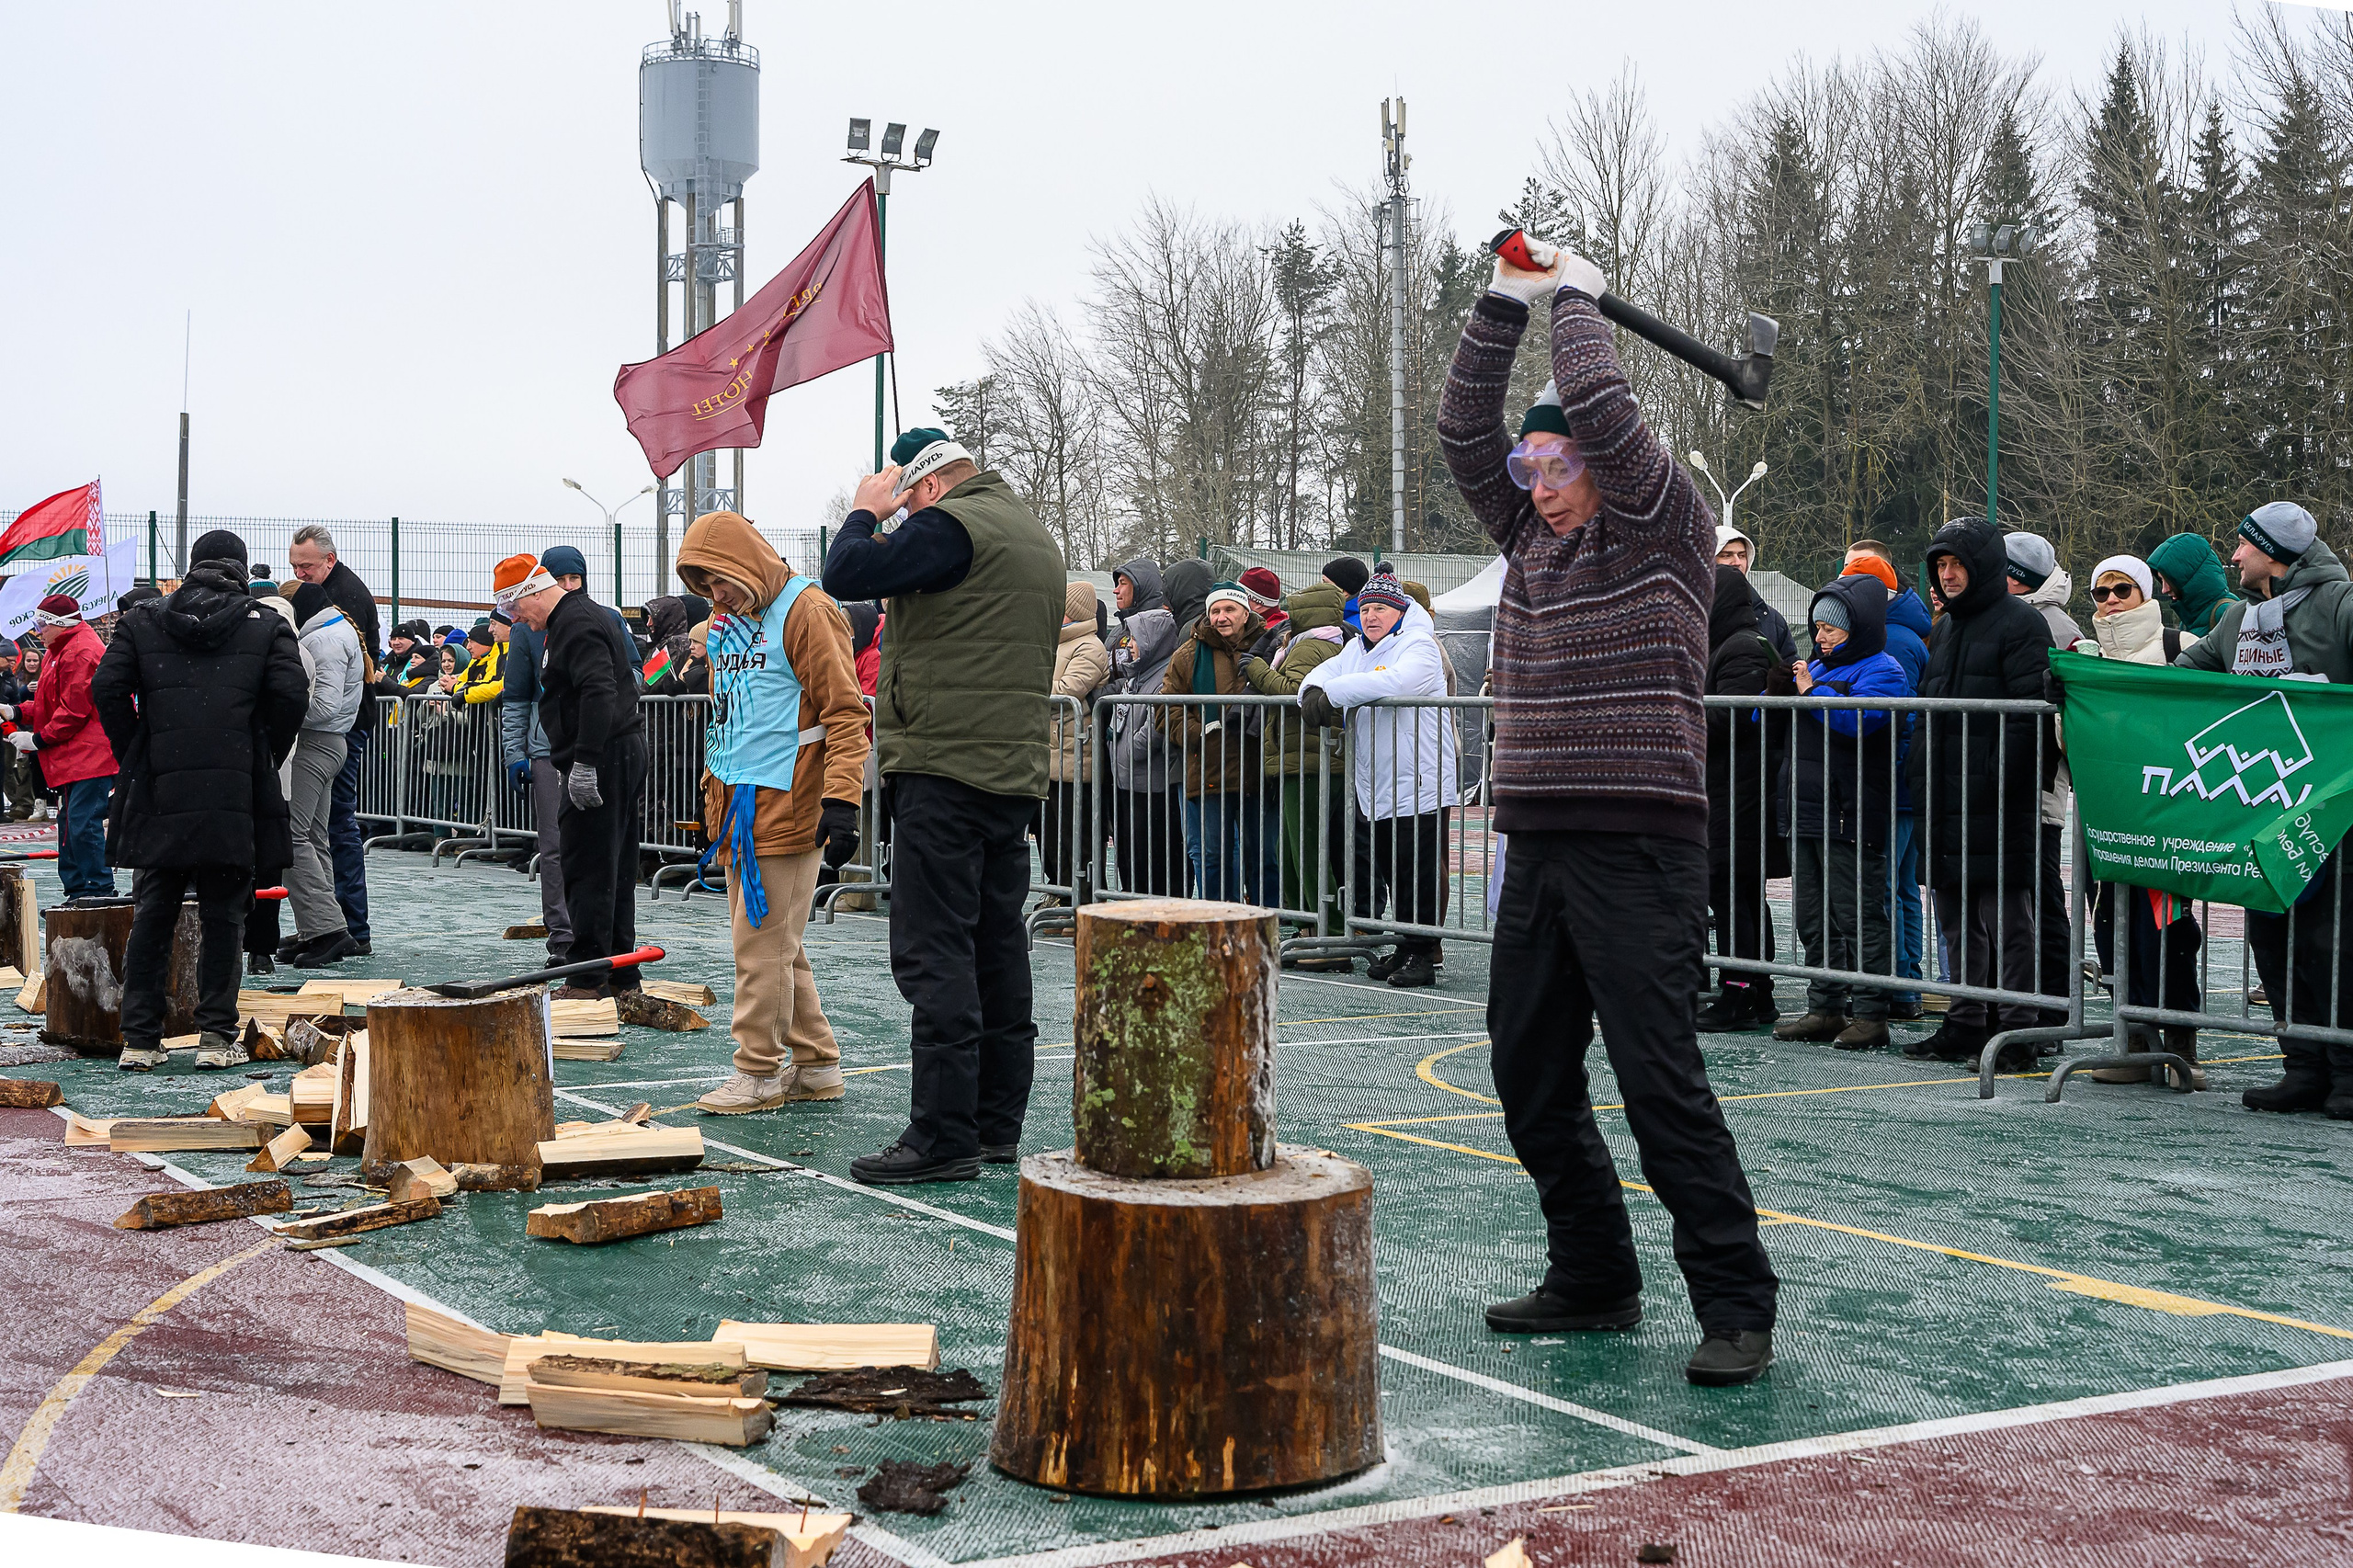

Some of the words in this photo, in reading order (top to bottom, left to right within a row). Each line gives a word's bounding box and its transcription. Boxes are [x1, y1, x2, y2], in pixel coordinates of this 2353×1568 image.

[2243, 521, 2275, 554] БЕЛАРУСЬ
[2238, 647, 2285, 665] ЕДИНЫЕ
[2086, 824, 2155, 847] Государственное
[2162, 836, 2236, 853] учреждение
[2133, 856, 2168, 870] делами
[2170, 856, 2240, 875] Президента
